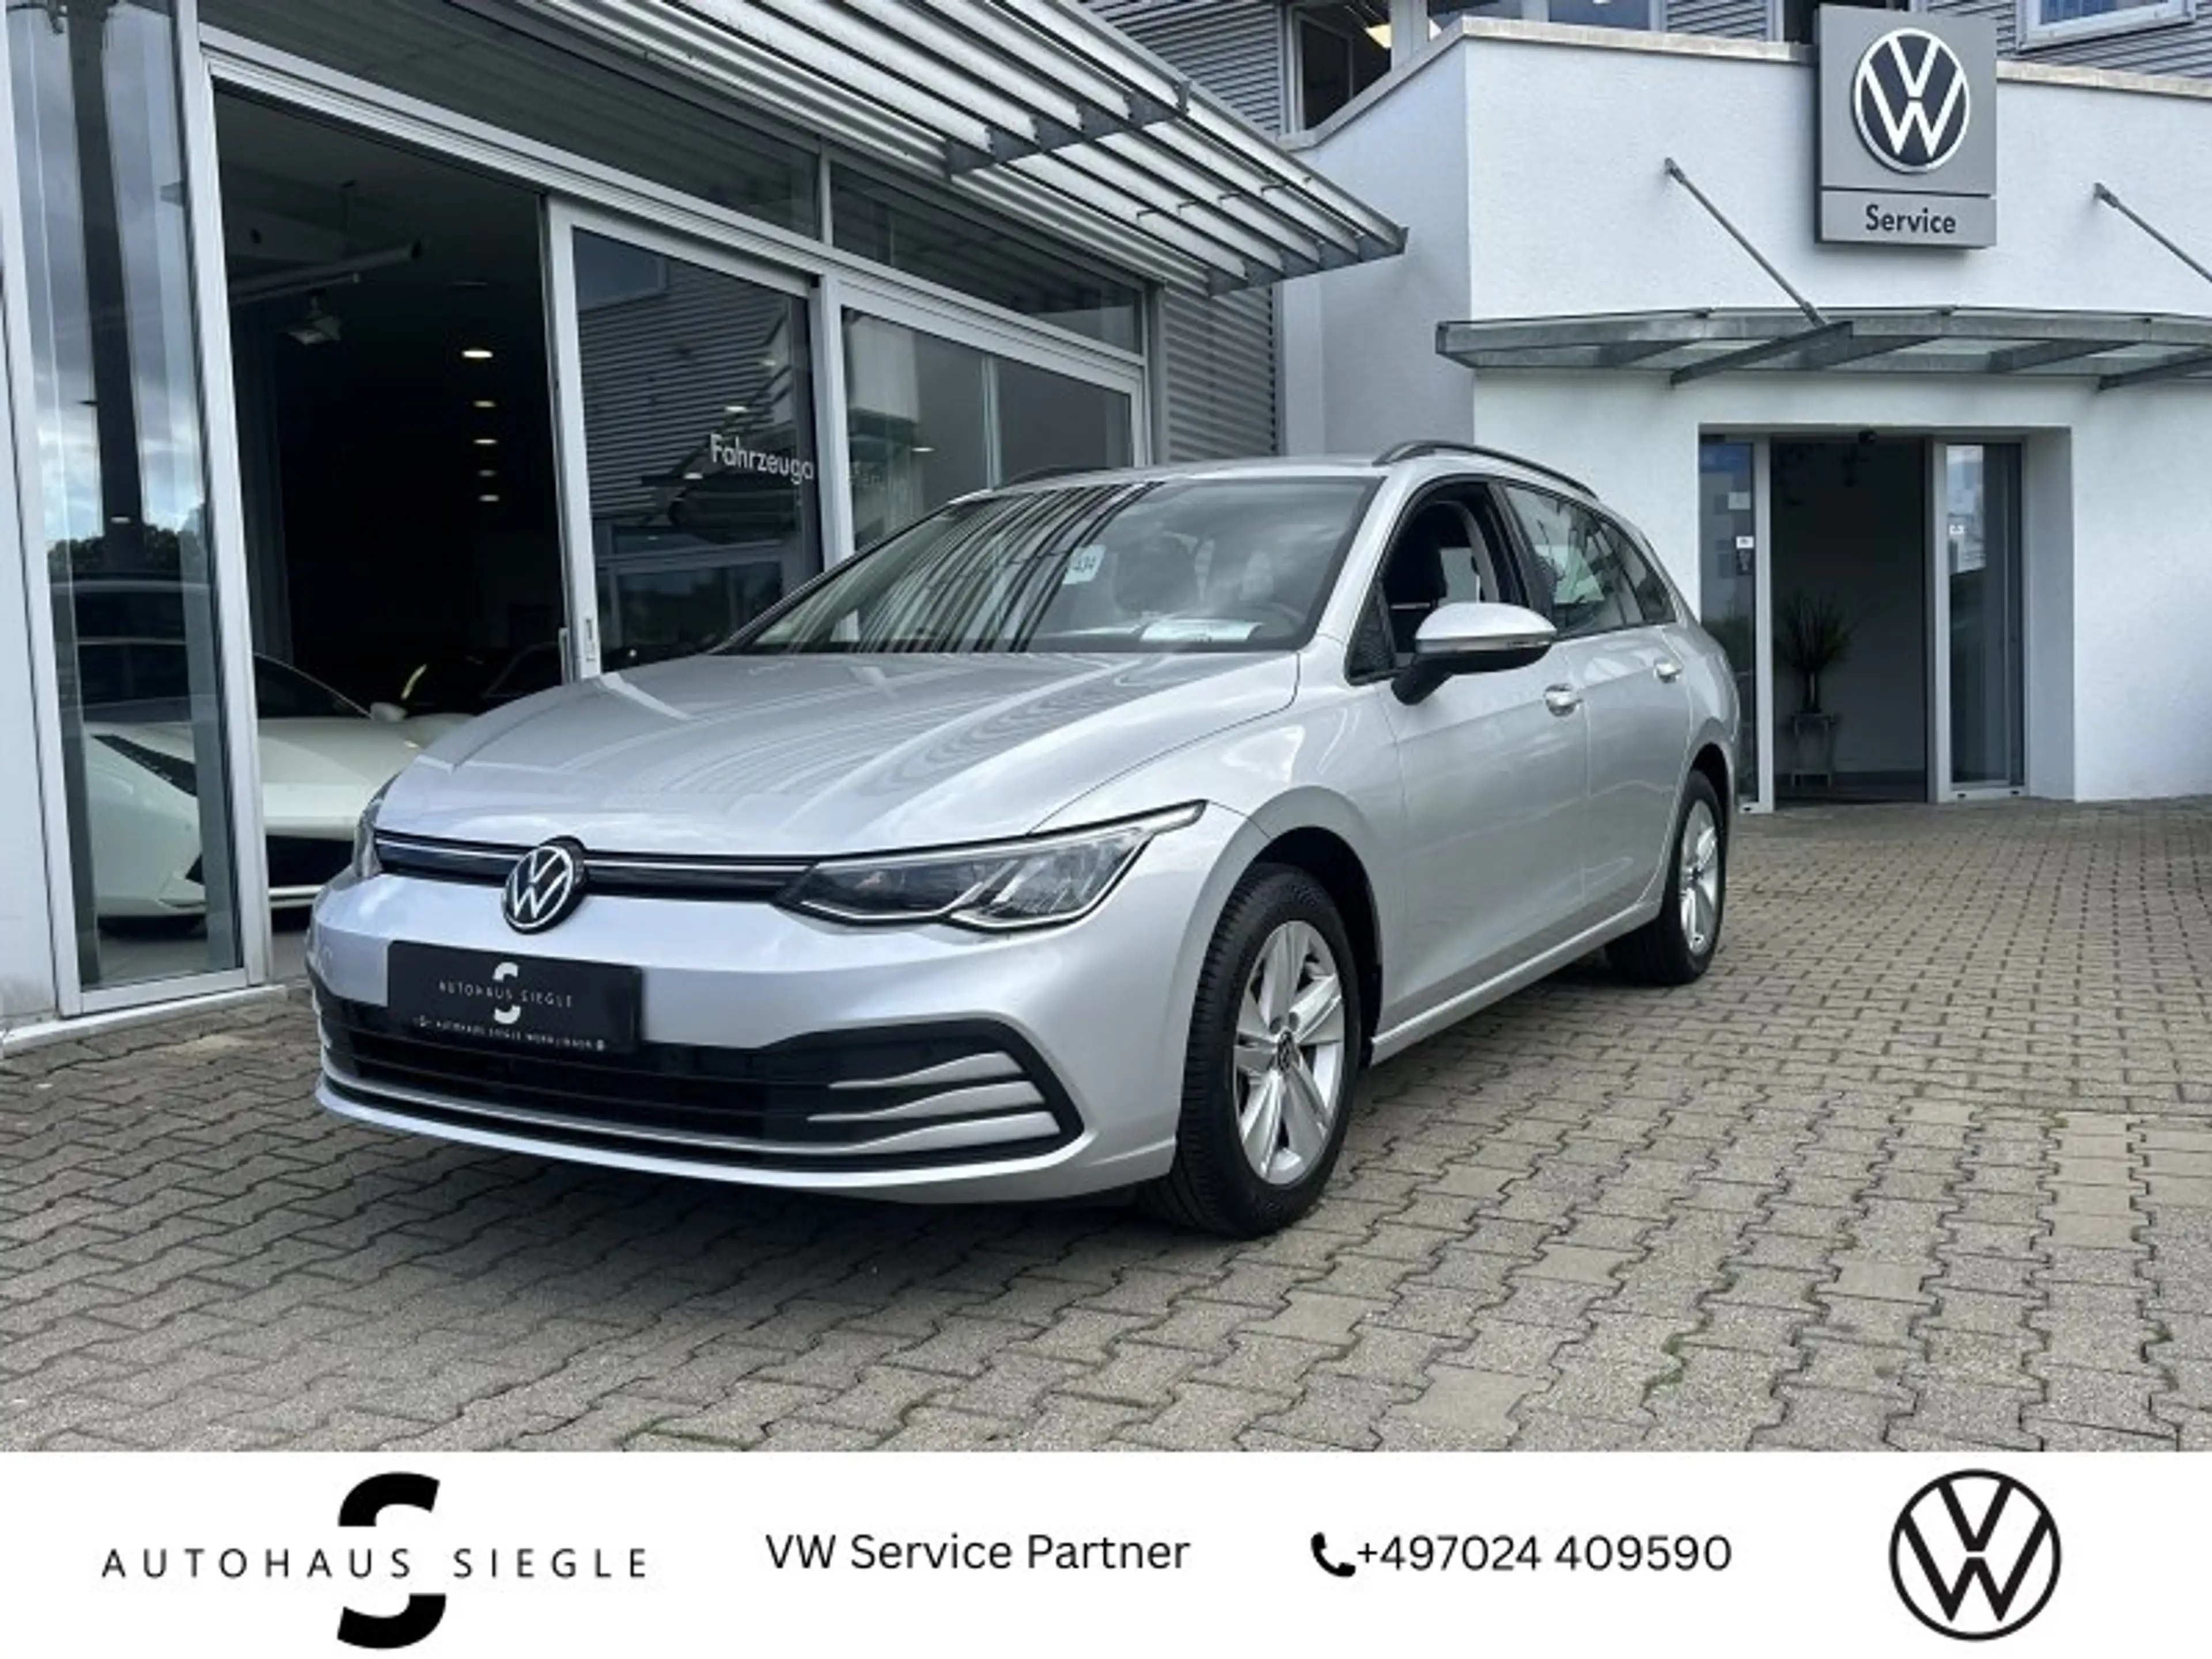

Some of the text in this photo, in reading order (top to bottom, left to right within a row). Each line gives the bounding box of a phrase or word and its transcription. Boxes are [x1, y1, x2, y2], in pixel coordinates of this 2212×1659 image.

[1865, 203, 1957, 234] Service
[438, 980, 573, 1009] AUTOHAUS SIEGLE
